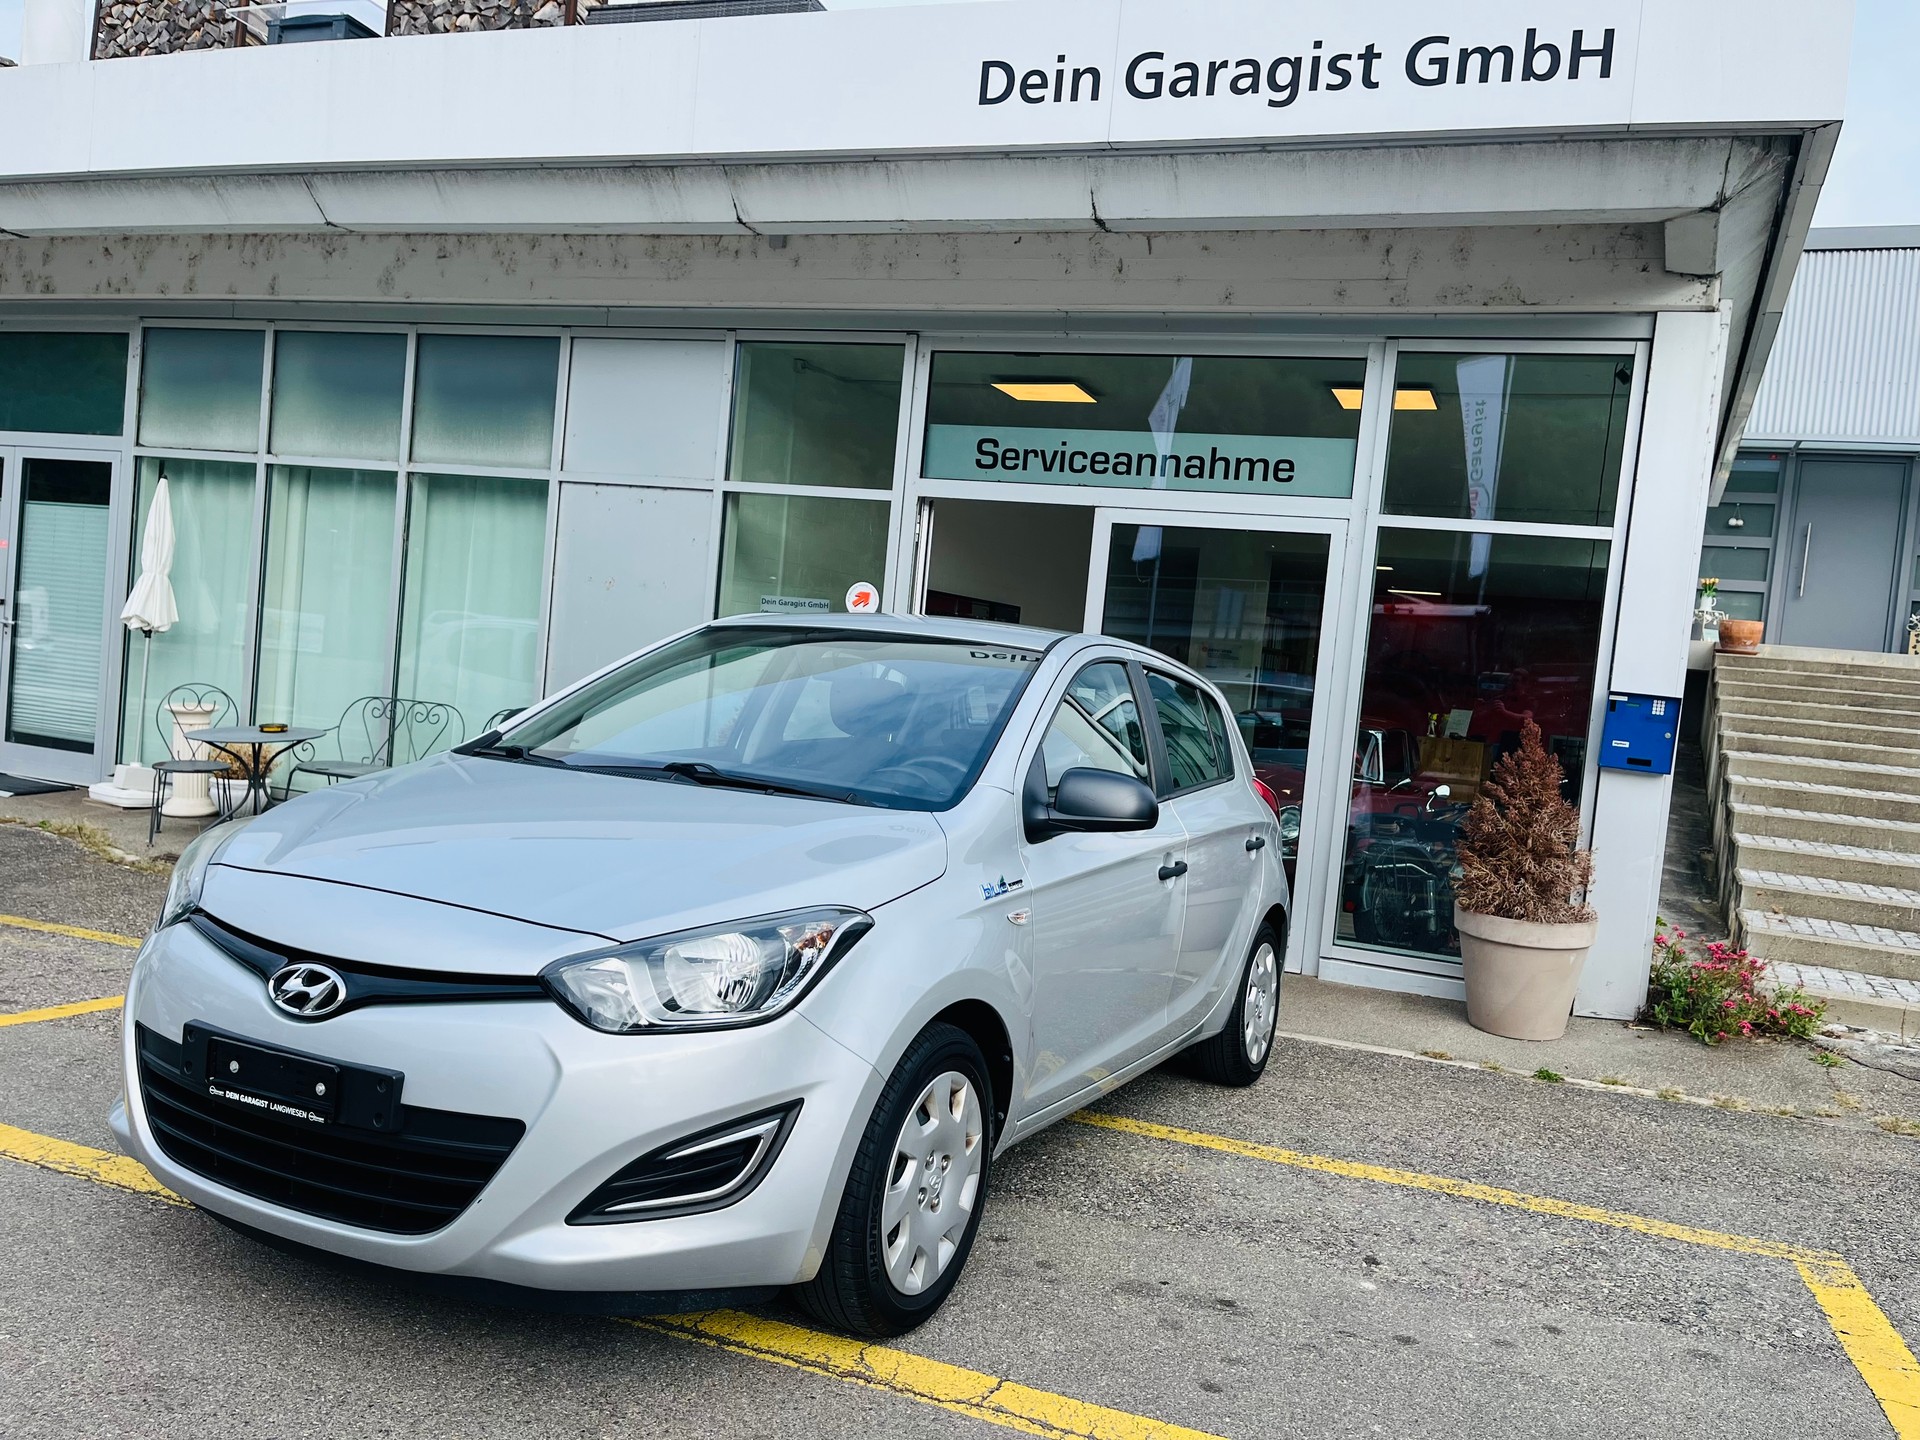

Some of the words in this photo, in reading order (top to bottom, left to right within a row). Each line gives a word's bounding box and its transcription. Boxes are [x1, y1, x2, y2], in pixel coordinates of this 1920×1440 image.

[979, 55, 1100, 105] Dein
[1126, 41, 1382, 107] Garagist
[1405, 28, 1615, 86] GmbH
[975, 438, 1295, 483] Serviceannahme
[761, 597, 777, 606] Dein
[778, 598, 807, 609] Garagist
[807, 601, 829, 609] GmbH
[225, 1090, 239, 1100] DEIN
[240, 1094, 268, 1108] GARAGIST
[269, 1102, 307, 1118] LANGWIESEN
